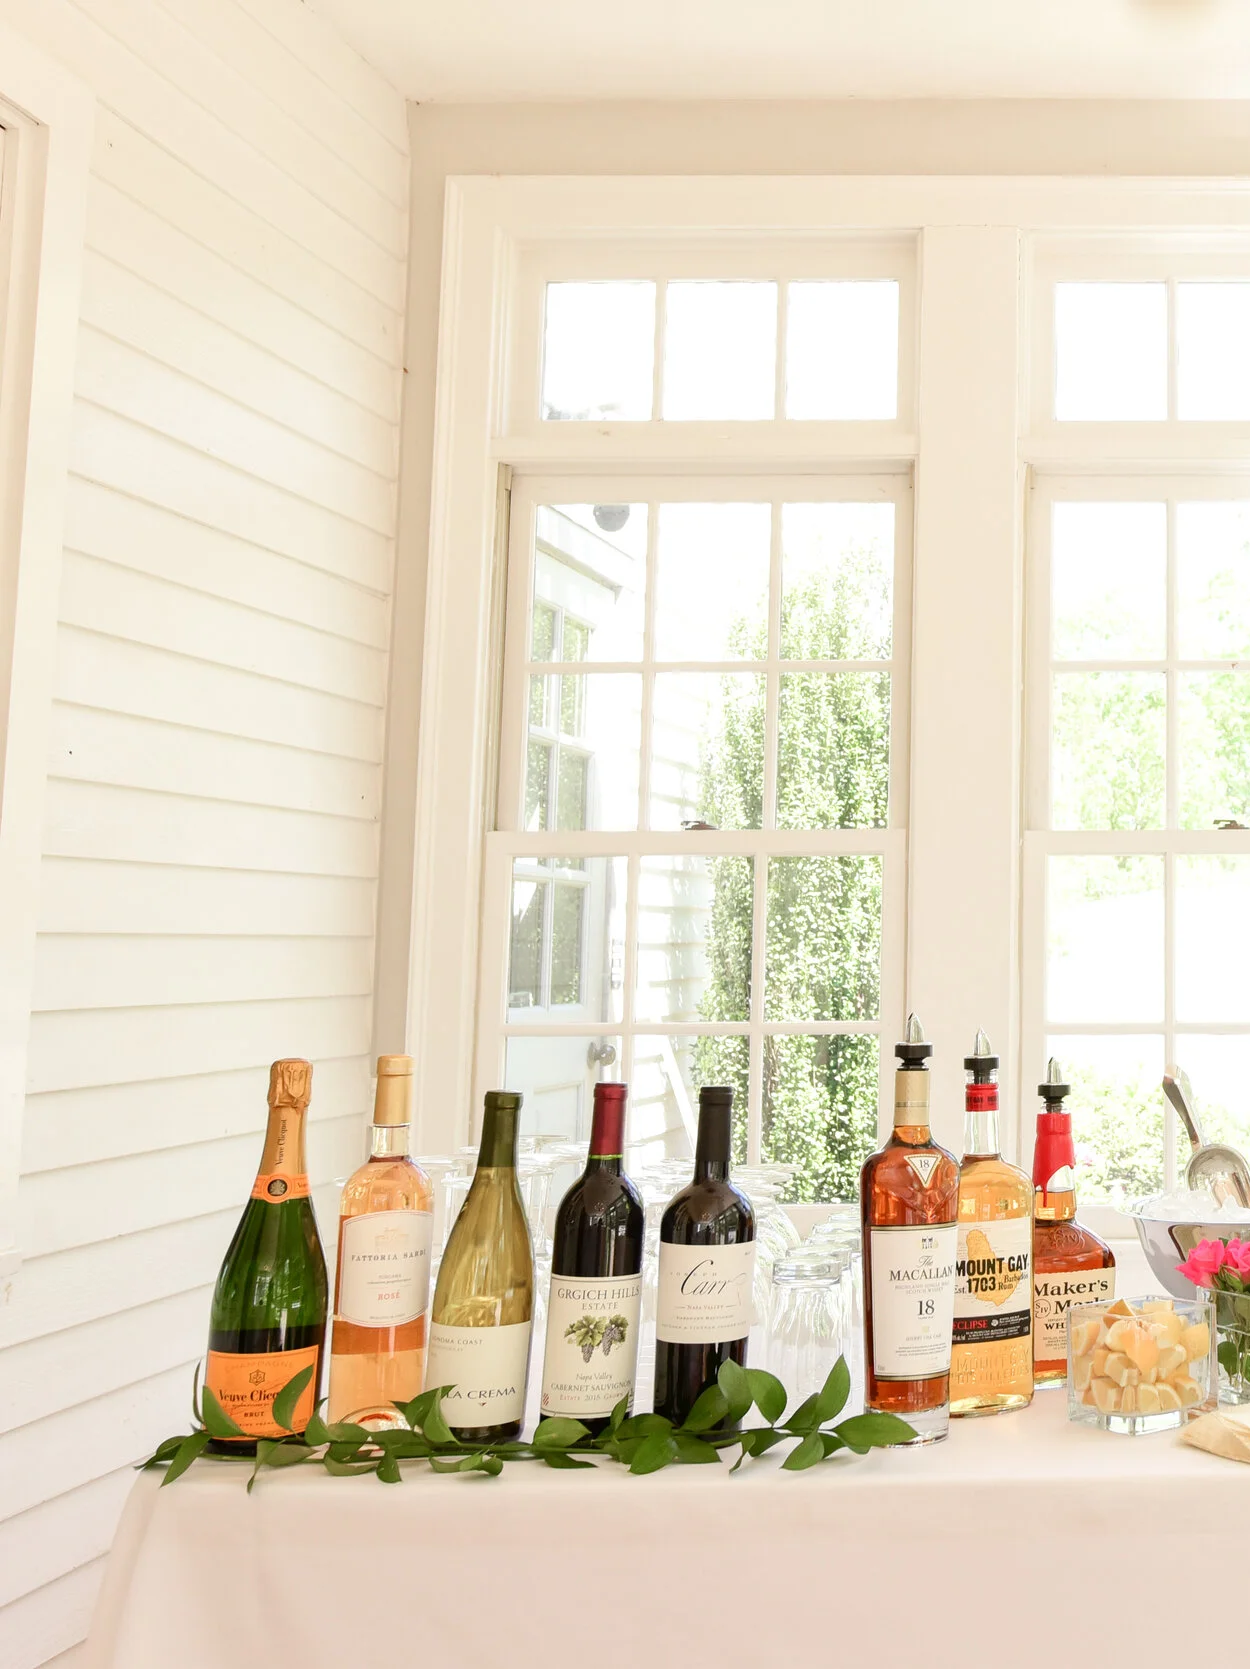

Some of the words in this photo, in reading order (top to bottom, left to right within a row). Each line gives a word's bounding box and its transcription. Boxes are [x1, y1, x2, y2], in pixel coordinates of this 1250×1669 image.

[277, 1119, 288, 1146] Clicquot
[275, 1147, 284, 1166] Veuve
[919, 1159, 930, 1169] 18
[351, 1254, 398, 1262] FATTORIA
[916, 1255, 934, 1268] The
[955, 1258, 1005, 1277] MOUNT
[1007, 1253, 1028, 1273] GAY
[680, 1259, 732, 1296] Carr
[889, 1265, 953, 1281] MACALLAN
[1004, 1272, 1029, 1284] Barbados
[557, 1287, 607, 1300] GRGICH
[611, 1284, 640, 1299] HILLS
[966, 1276, 996, 1294] 1703
[998, 1281, 1014, 1290] Rum
[1035, 1279, 1109, 1297] Maker's
[582, 1301, 619, 1311] ESTATE
[917, 1299, 935, 1316] 18
[953, 1319, 988, 1330] ECLIPSE
[575, 1368, 593, 1384] Napa
[593, 1372, 613, 1382] Valley
[550, 1382, 590, 1392] CABERNET
[591, 1379, 632, 1391] SAUVIGNON
[219, 1388, 247, 1402] Veuve
[250, 1389, 280, 1402] Clicq
[446, 1390, 462, 1399] LA
[467, 1386, 516, 1400] CREMA
[243, 1410, 265, 1418] BRUT
